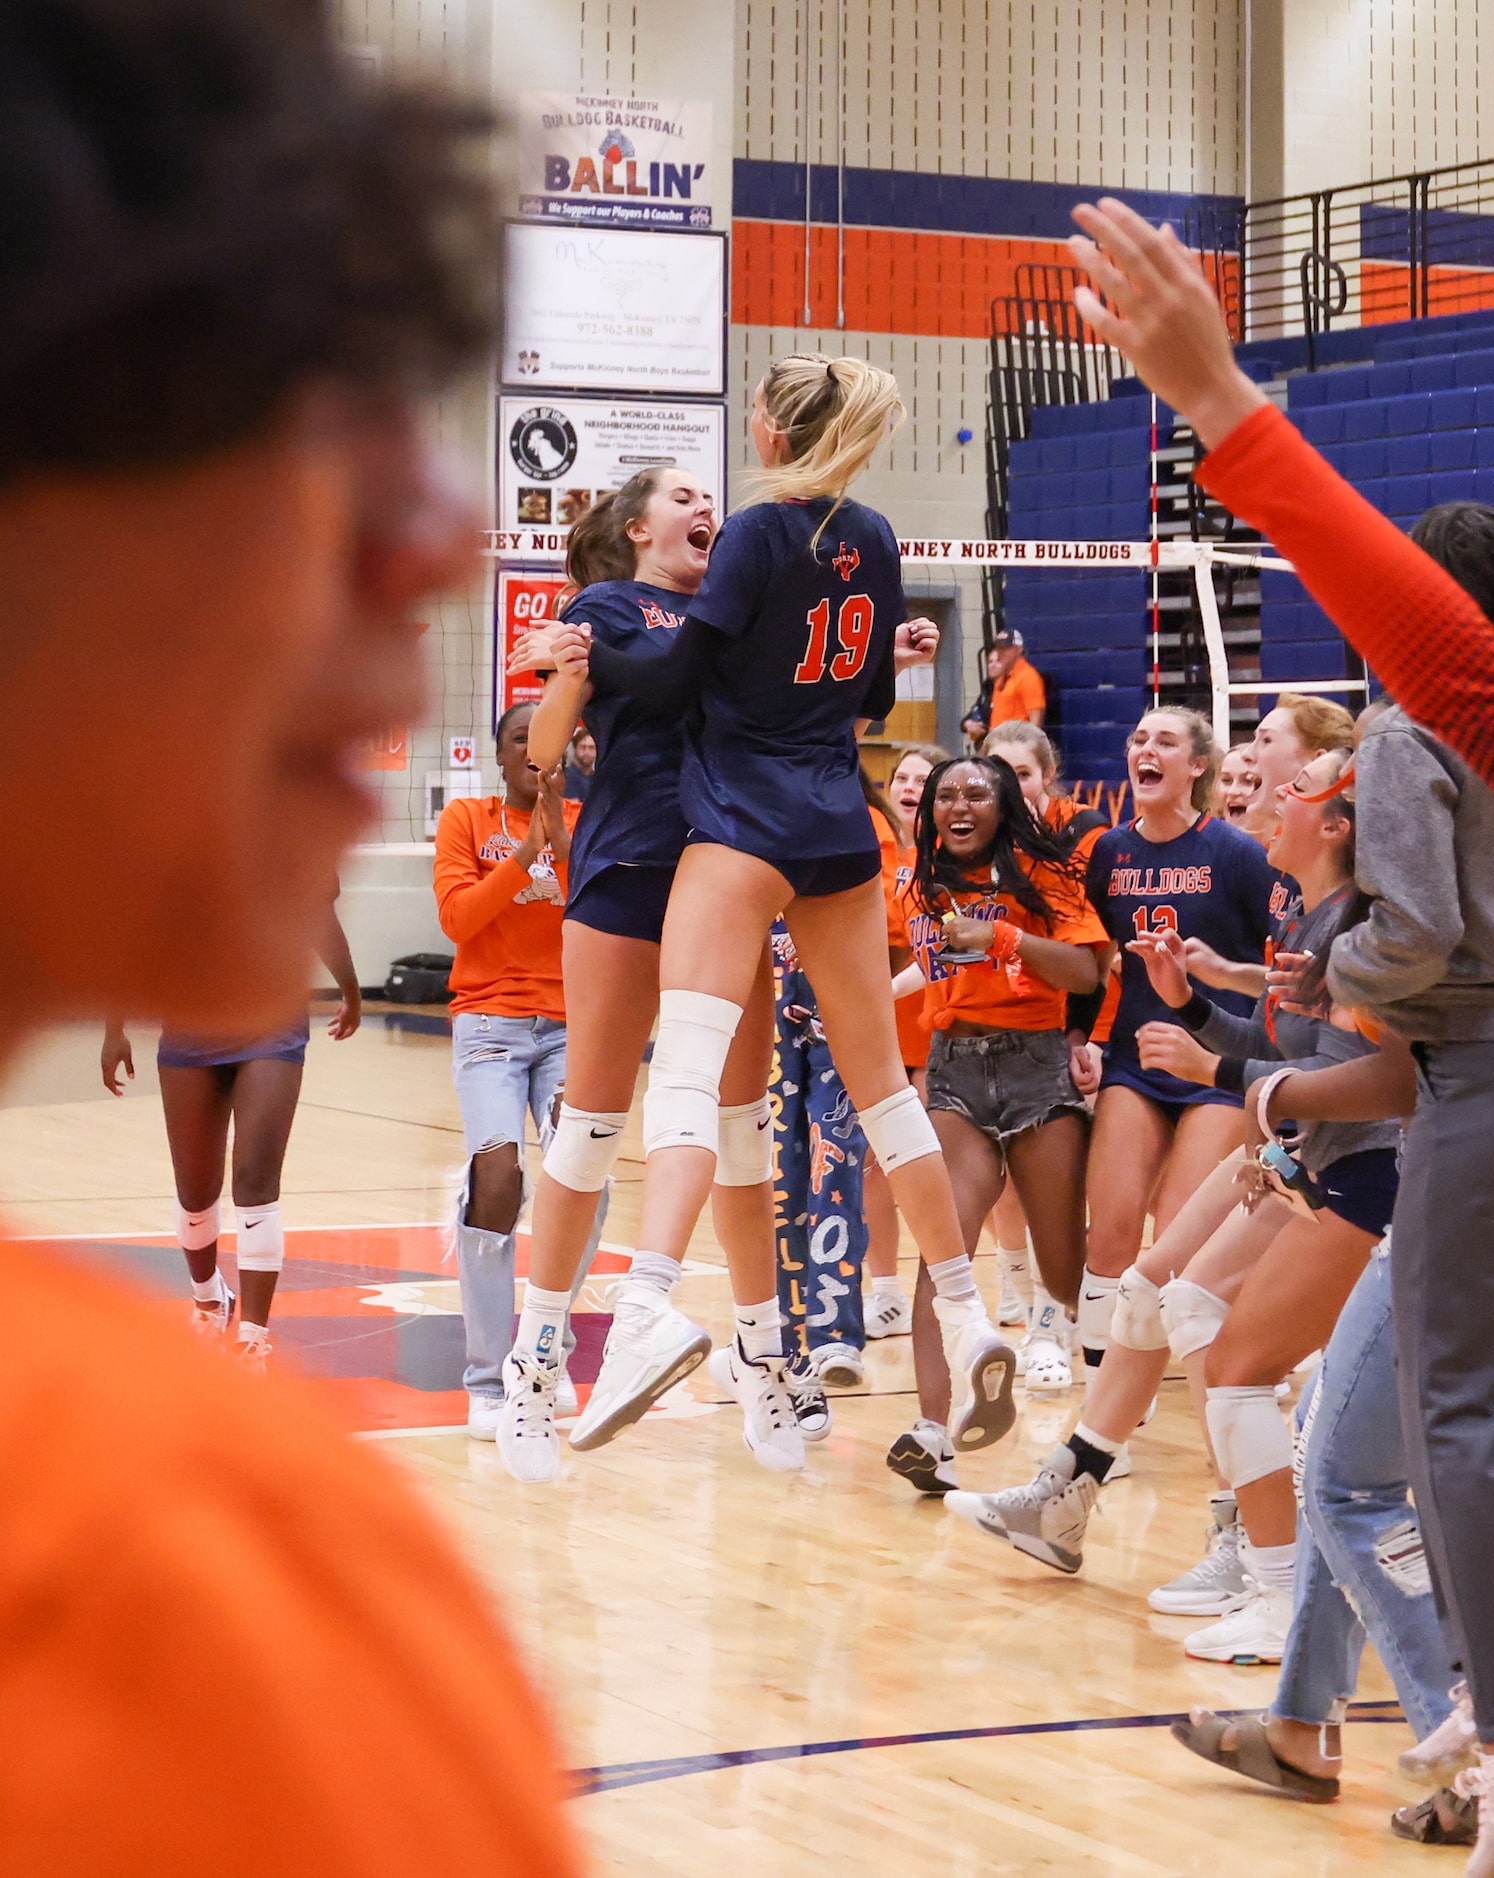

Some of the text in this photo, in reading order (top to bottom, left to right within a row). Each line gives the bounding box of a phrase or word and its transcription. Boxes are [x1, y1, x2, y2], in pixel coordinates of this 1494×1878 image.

[627, 99, 658, 111] NORTH
[542, 110, 684, 137] BULLDOG BASKETBALL
[544, 154, 705, 199] BALLIN'
[549, 202, 561, 212] We
[563, 203, 595, 218] Support
[597, 207, 611, 216] our
[612, 206, 641, 221] Players
[651, 208, 684, 221] Coaches
[550, 361, 711, 377] Supports McKinney North Boys Basketball
[610, 409, 686, 421] A WORLD-CLASS
[584, 420, 710, 434] NEIGHBORHOOD HANGOUT
[961, 543, 1016, 558] NORTH
[1035, 544, 1131, 559] BULLDOGS
[514, 592, 548, 618] GO
[793, 593, 874, 684] 19
[1108, 866, 1212, 896] BULLDOGS
[1132, 904, 1178, 940] 12
